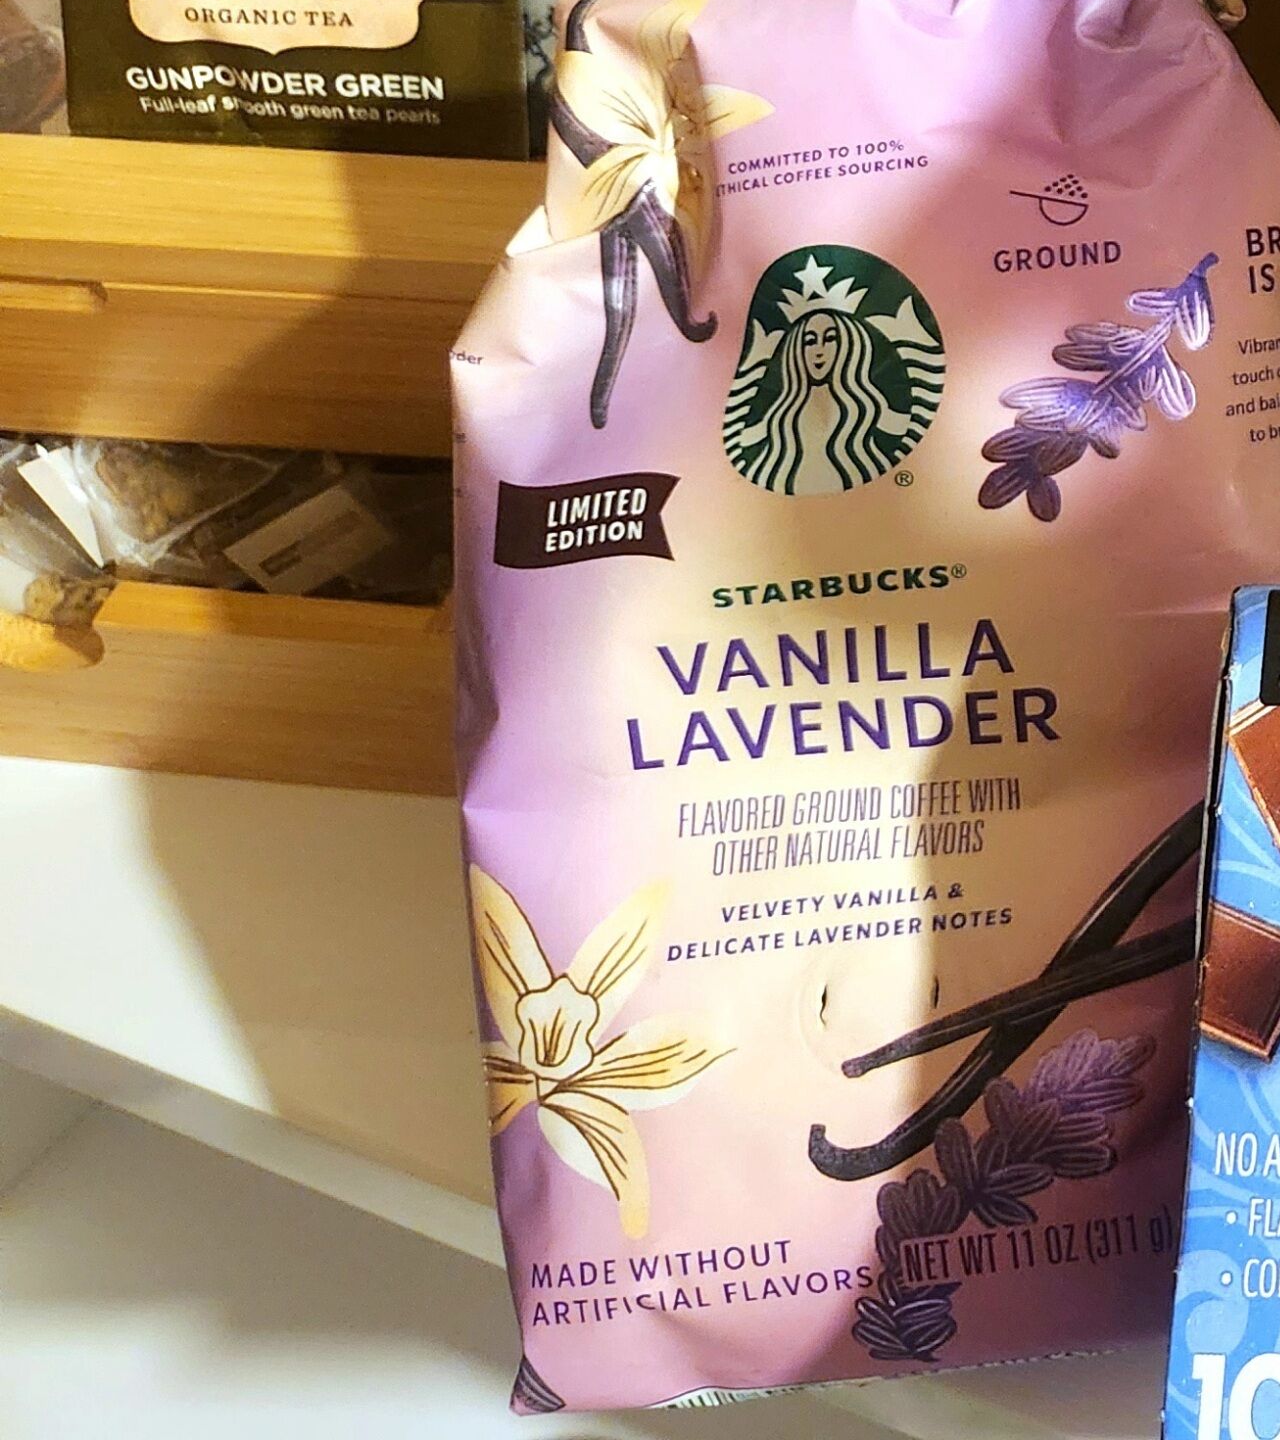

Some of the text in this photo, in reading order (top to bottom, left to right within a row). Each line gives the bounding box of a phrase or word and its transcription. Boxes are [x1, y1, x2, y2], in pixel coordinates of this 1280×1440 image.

[184, 7, 354, 28] ORGANIC TEA
[125, 65, 444, 100] GUNPOWDER GREEN
[289, 102, 343, 121] green
[348, 105, 380, 121] tea
[728, 140, 904, 174] COMMITTED TO 100%
[774, 167, 832, 186] COFFEE
[838, 155, 929, 176] SOURCING
[993, 240, 1122, 274] GROUND
[1248, 263, 1275, 294] IS
[1233, 365, 1275, 386] touch
[1225, 396, 1256, 417] and
[546, 486, 648, 528] LIMITED
[544, 519, 644, 554] EDITION
[656, 618, 1015, 696] VANILLA
[625, 688, 1061, 771] LAVENDER
[678, 776, 1022, 838] FLAVORED GROUND COFFEE WITH
[711, 820, 985, 876] OTHER NATURAL FLAVORS
[720, 881, 964, 924] VELVETY VANILLA &
[666, 908, 1013, 962] DELICATE LAVENDER NOTES
[1212, 1131, 1255, 1175] NO
[530, 1239, 792, 1290] MADE WITHOUT
[904, 1240, 950, 1282] NET
[958, 1234, 998, 1276] WT
[1007, 1230, 1034, 1269] 11
[1044, 1224, 1076, 1264] OZ
[530, 1265, 873, 1328] ARTIFICIAL FLAVORS
